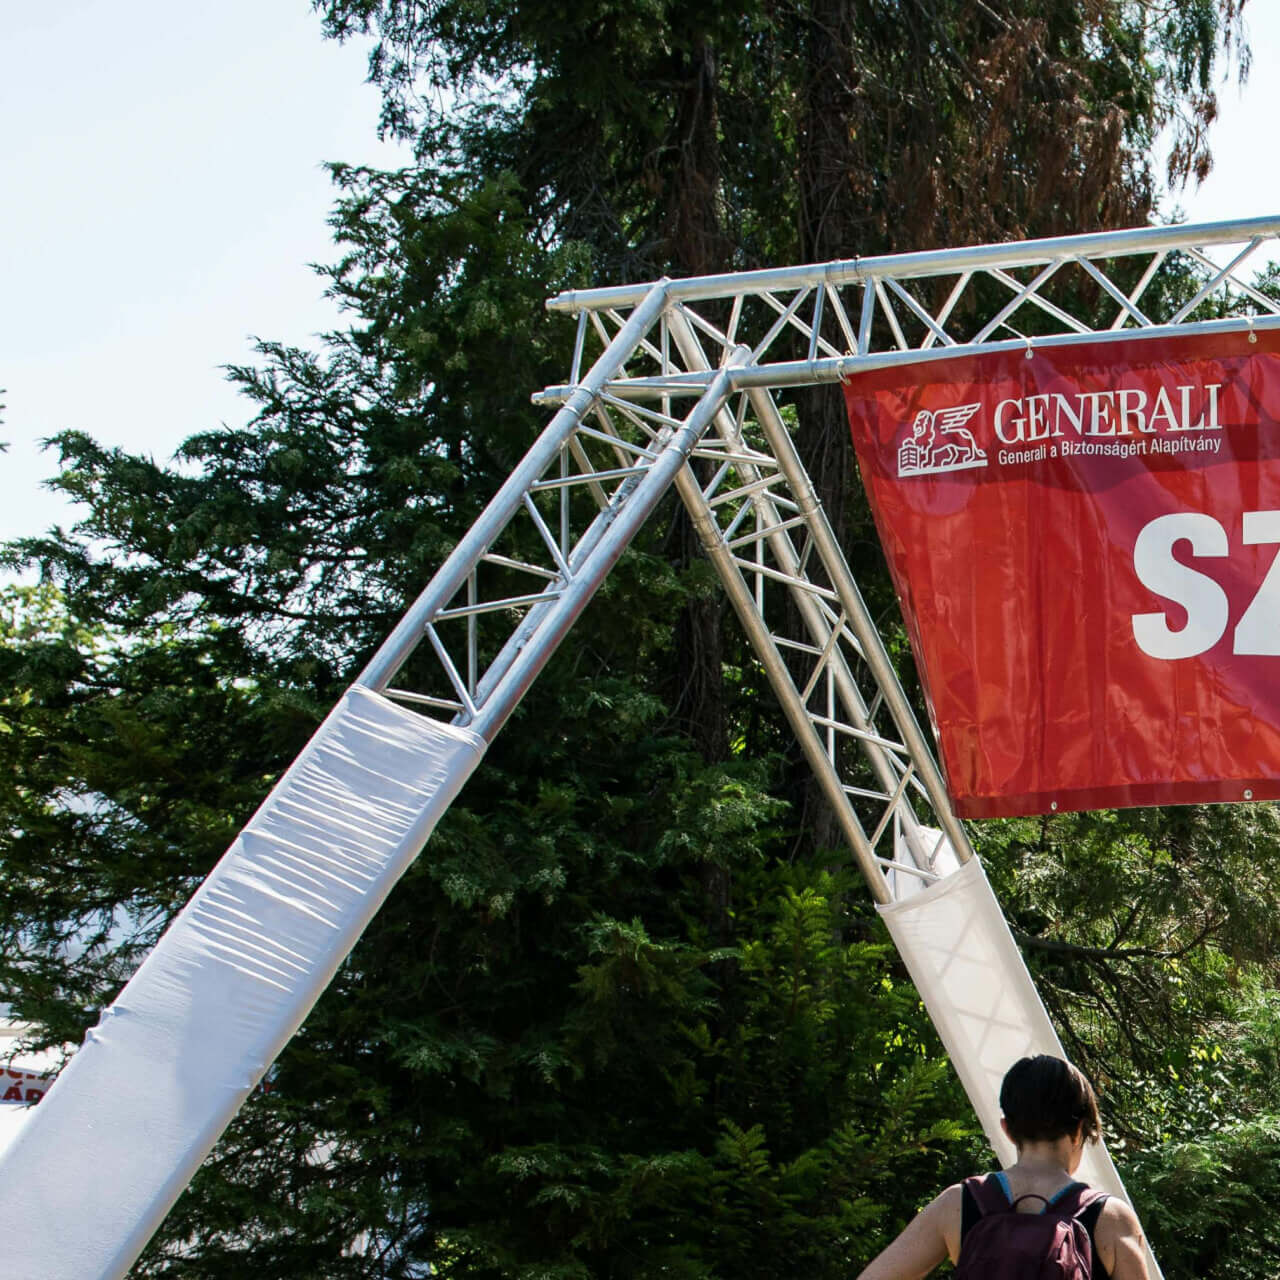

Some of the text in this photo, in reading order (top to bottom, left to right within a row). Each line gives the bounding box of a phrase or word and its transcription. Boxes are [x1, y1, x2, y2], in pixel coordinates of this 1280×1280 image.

[994, 385, 1222, 444] GENERALI
[998, 436, 1222, 465] Generali a Biztonságért Alapítvány
